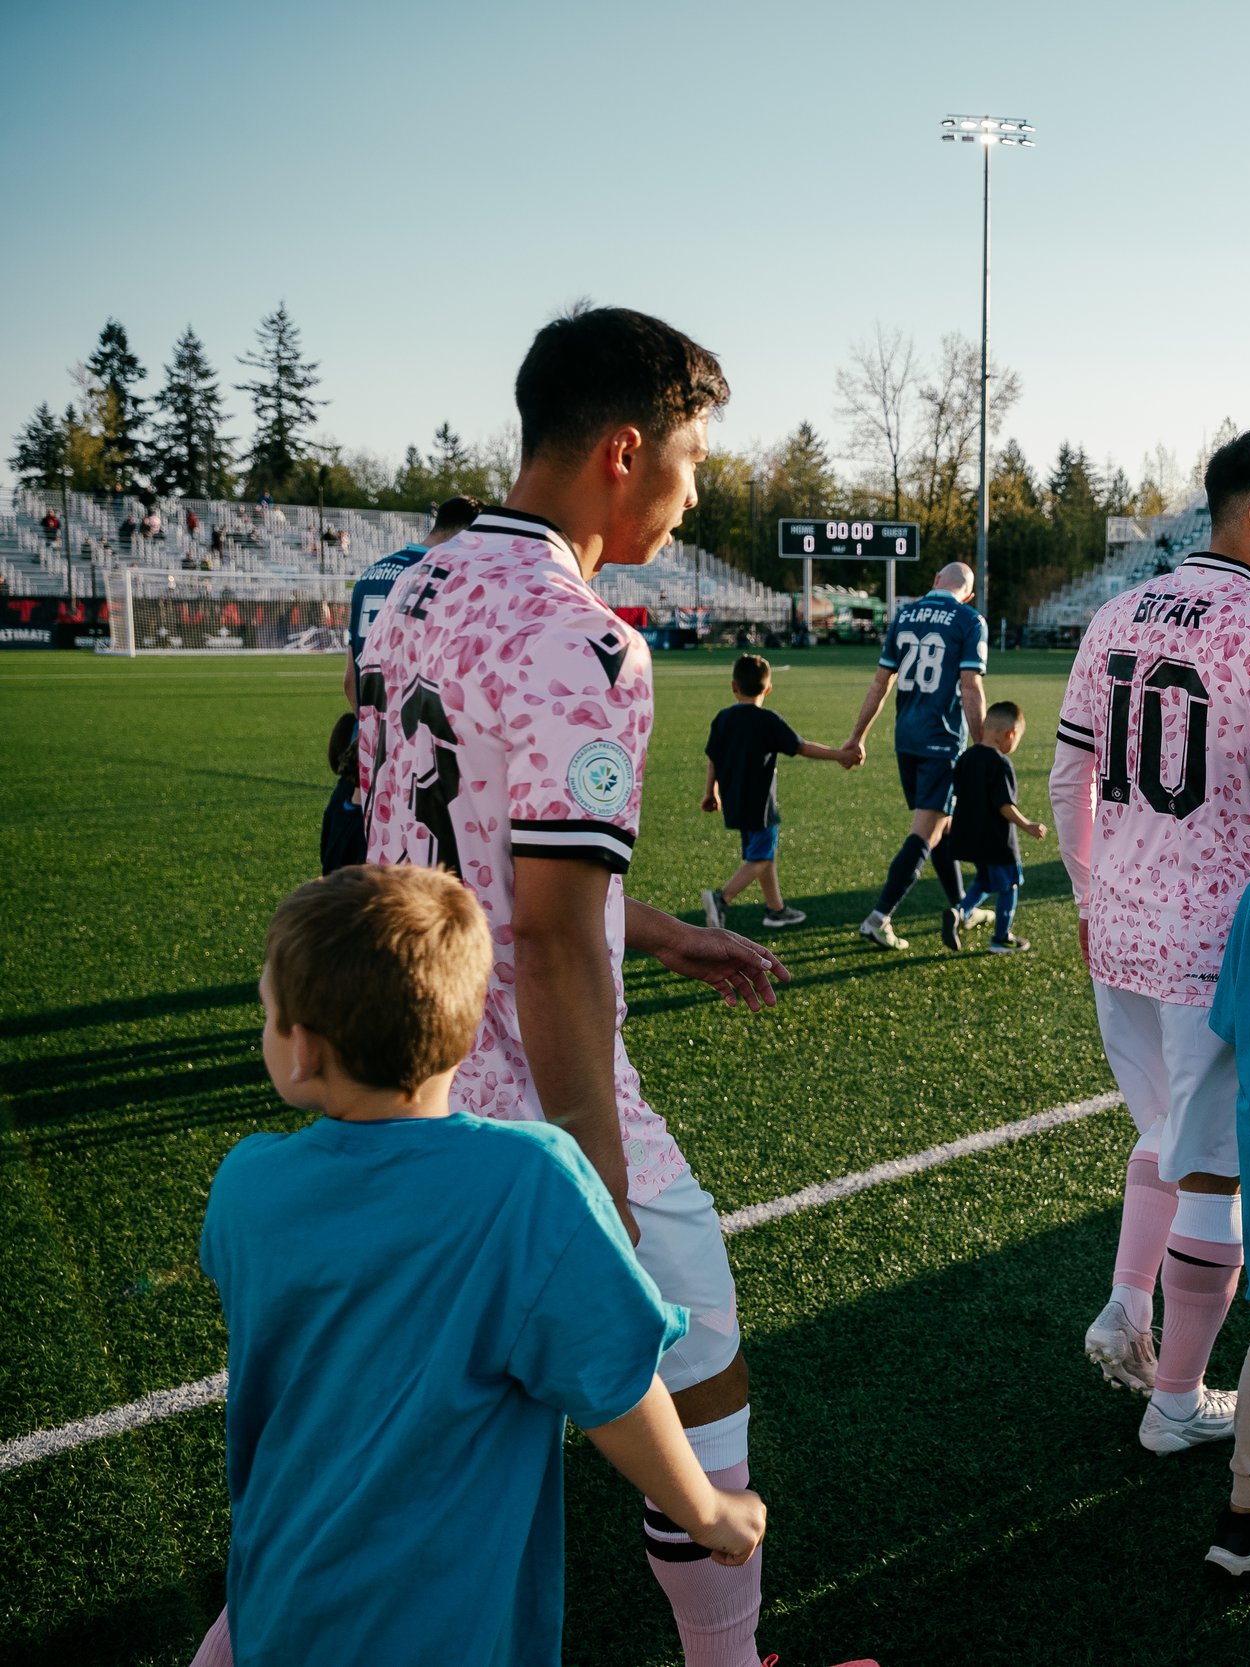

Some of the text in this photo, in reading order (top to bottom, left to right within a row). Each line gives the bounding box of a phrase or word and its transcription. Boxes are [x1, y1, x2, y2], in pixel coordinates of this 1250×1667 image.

[790, 525, 815, 535] HOME
[881, 527, 908, 537] GUEST
[803, 535, 815, 552] 0
[895, 537, 907, 555] 0
[899, 608, 955, 626] G-LAPARÉ
[1133, 592, 1211, 629] BITAR
[0, 629, 51, 643] LTIMATE
[896, 631, 946, 693] 28
[1099, 648, 1210, 820] 10
